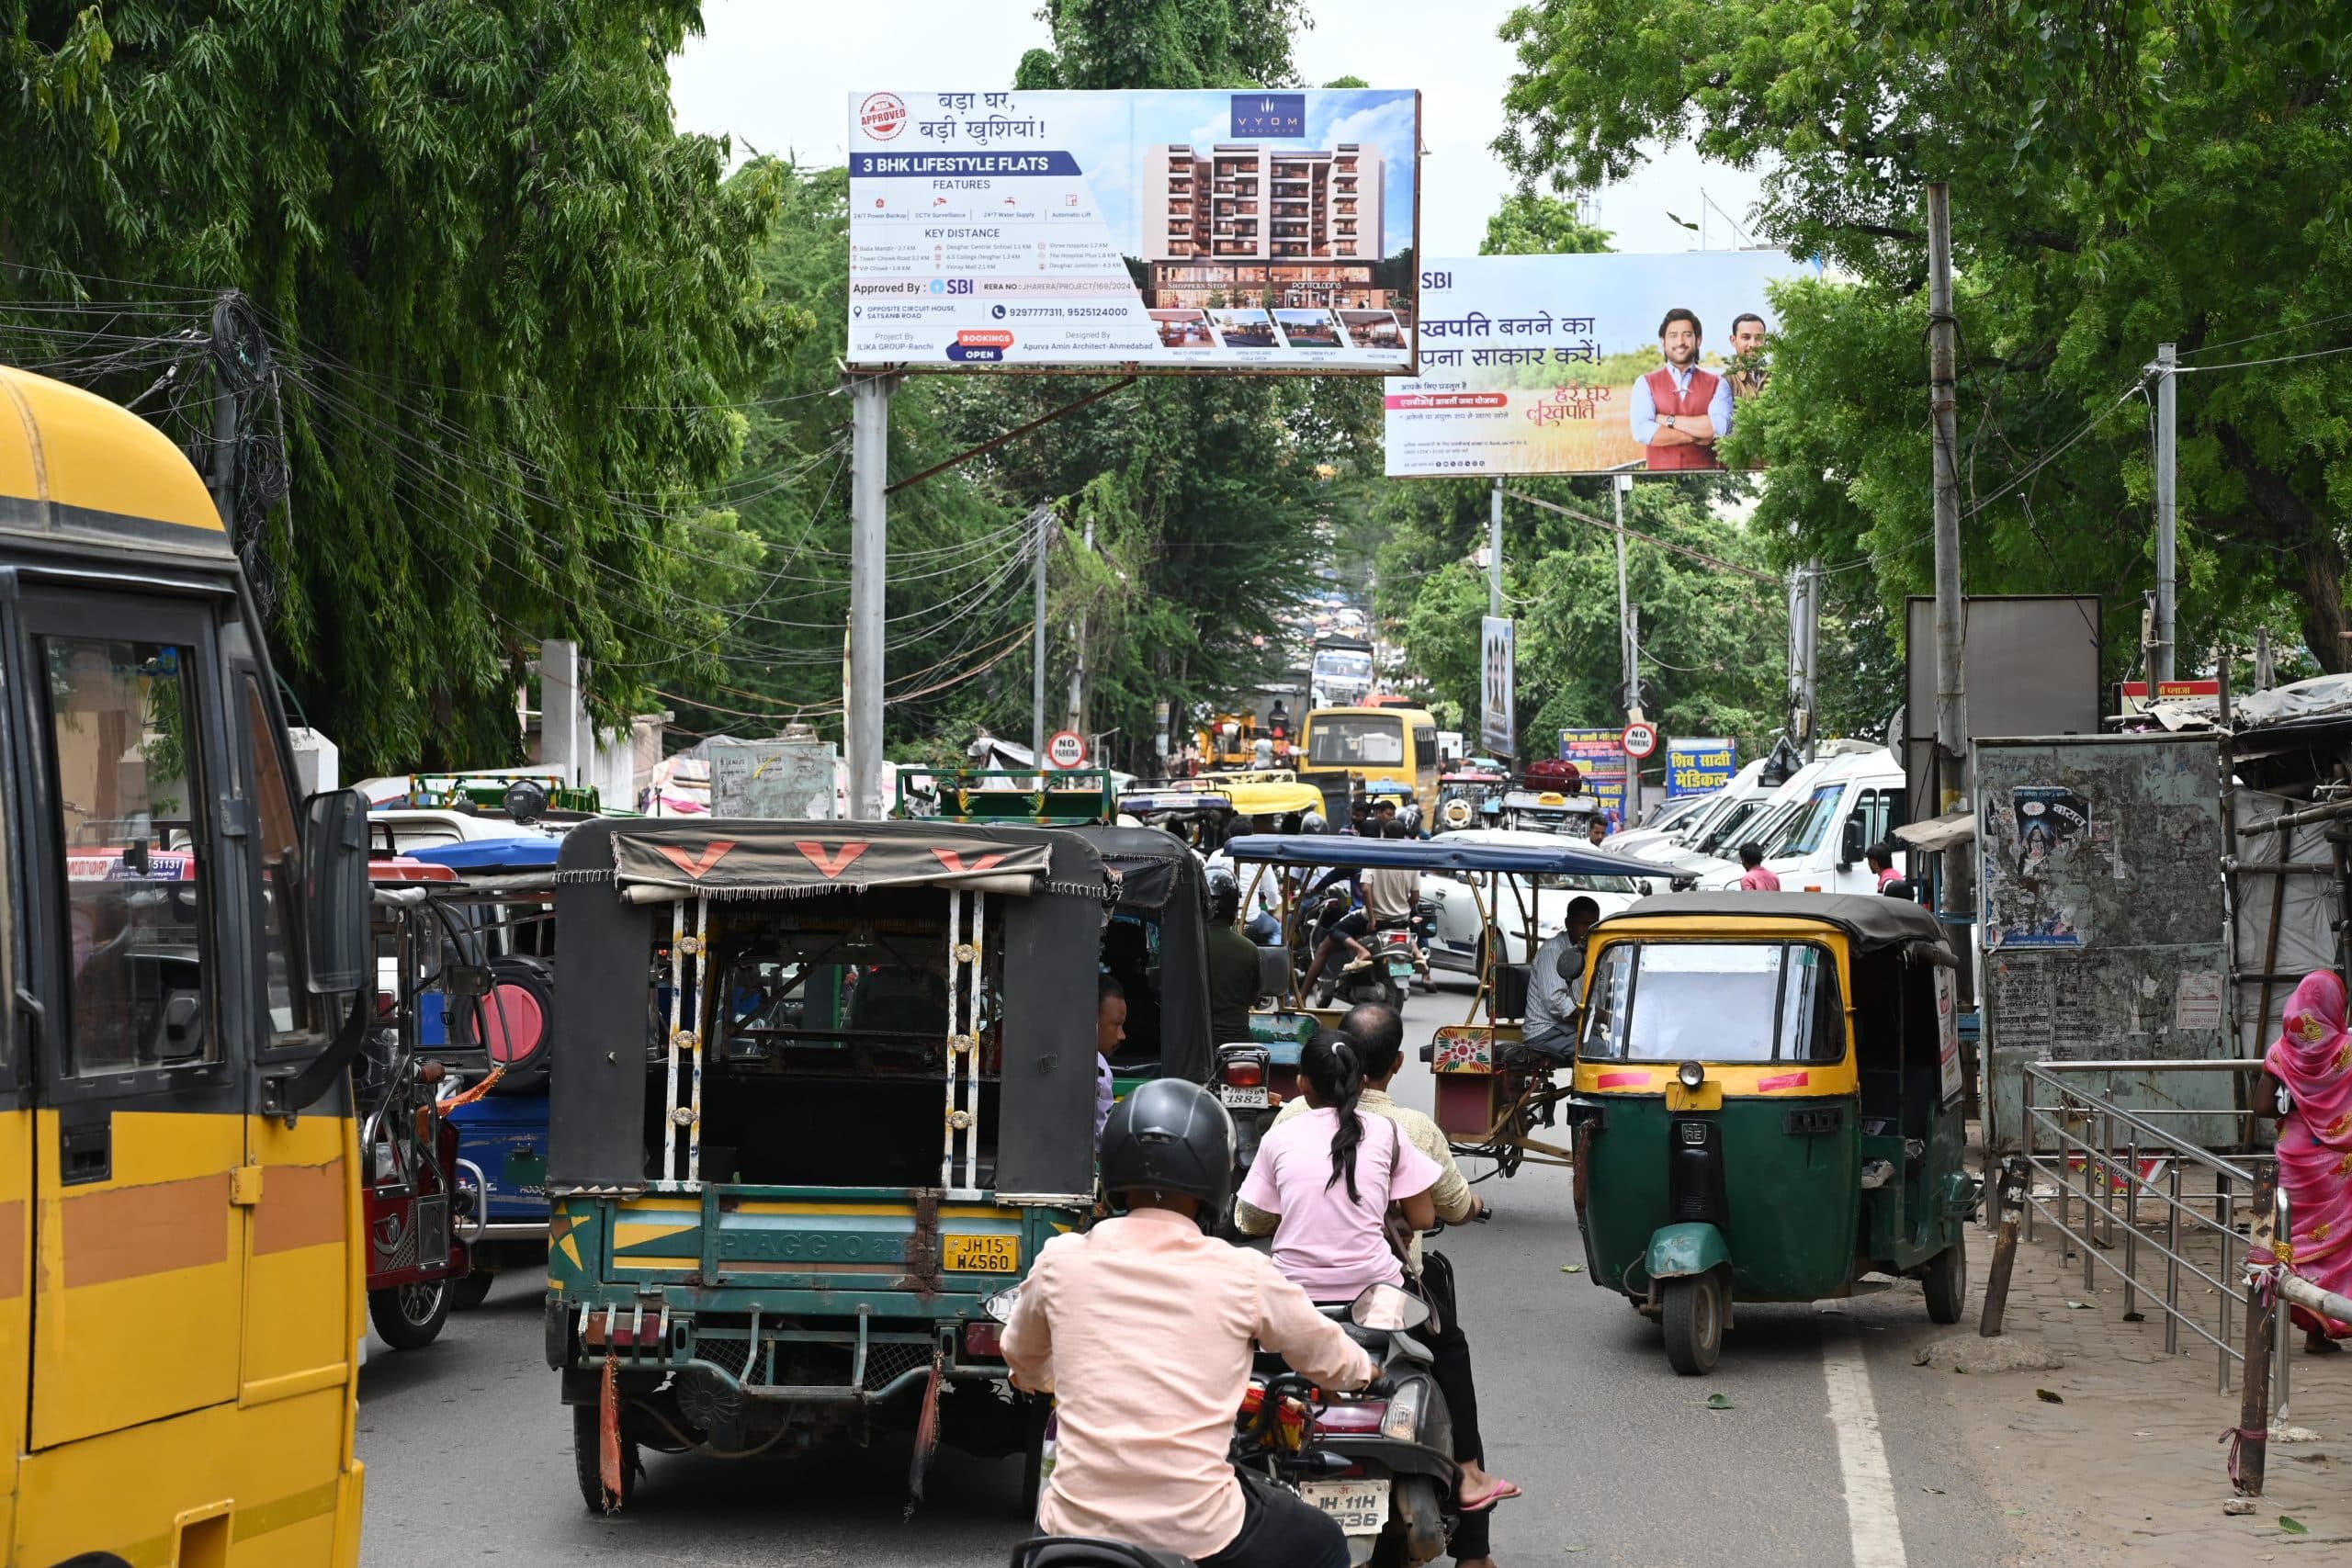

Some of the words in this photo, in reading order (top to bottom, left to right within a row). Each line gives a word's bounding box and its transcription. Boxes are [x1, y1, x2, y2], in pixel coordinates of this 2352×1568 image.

[938, 93, 976, 114] बड़ा
[984, 93, 1015, 112] घर,
[861, 108, 906, 126] APPROVED
[1238, 118, 1298, 126] VYOM
[919, 116, 956, 143] बड़ी
[864, 159, 872, 173] 3
[877, 158, 910, 172] BHK
[913, 158, 994, 172] LIFESTYLE
[999, 156, 1048, 171] FLATS
[933, 180, 990, 189] FEATURES
[924, 229, 944, 238] KEY
[947, 229, 1001, 238] DISTANCE
[1421, 271, 1452, 289] SBI
[854, 283, 904, 294] Approved
[907, 284, 921, 294] By
[946, 279, 974, 294] SBI
[1010, 309, 1065, 317] 9297777311,
[1068, 309, 1128, 317] 9525124000
[1419, 311, 1491, 337] खपति
[1498, 310, 1554, 335] बनने
[1561, 318, 1595, 334] का
[875, 333, 902, 342] Project
[904, 333, 914, 341] By
[962, 334, 1011, 343] BOOKINGS
[1066, 332, 1100, 340] Designed
[1072, 342, 1153, 350] Architect-Ahmedabad
[966, 351, 994, 359] OPEN
[1419, 350, 1464, 367] पना
[1472, 348, 1546, 367] साकार
[1554, 340, 1601, 366] करें!
[1424, 381, 1437, 389] लिए
[1584, 385, 1611, 401] घर
[1058, 739, 1075, 748] NO
[1627, 739, 1649, 748] PARKING
[1055, 749, 1079, 757] PARKING
[1670, 752, 1696, 768] शिव
[1699, 750, 1732, 767] साक्षी
[1674, 770, 1728, 787] मेडिकल
[2052, 803, 2087, 827] बारात
[1227, 1095, 1262, 1104] 1882
[1685, 1130, 1702, 1140] RE
[721, 1232, 865, 1258] PIAGGIO
[963, 1238, 982, 1252] JH
[986, 1238, 1003, 1252] 15
[956, 1255, 1009, 1269] W4560
